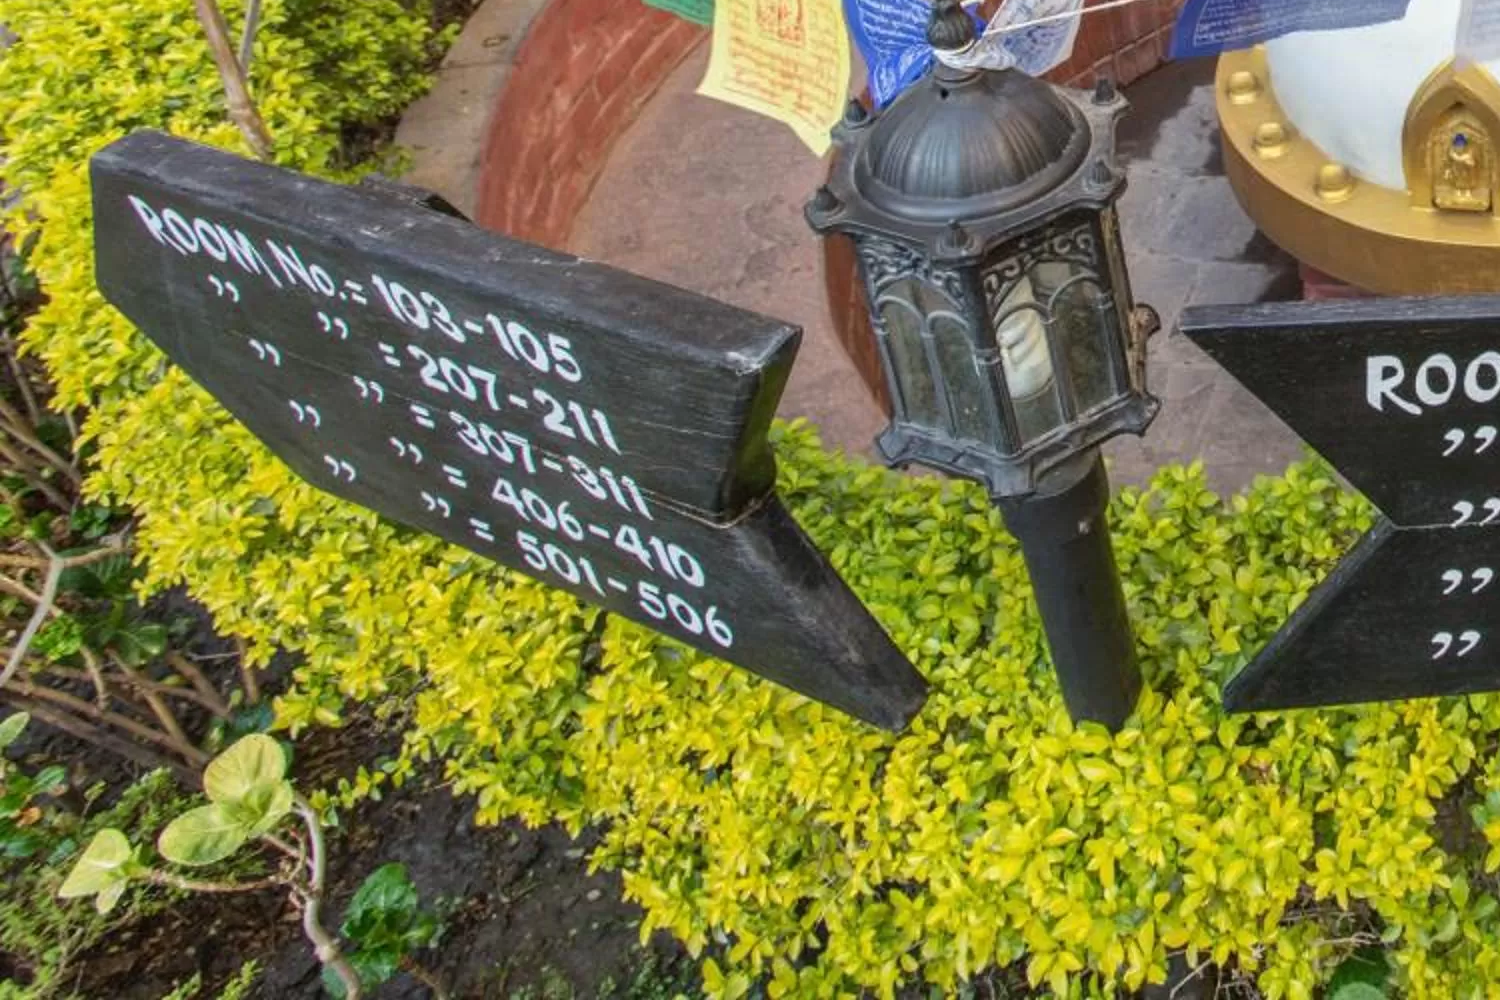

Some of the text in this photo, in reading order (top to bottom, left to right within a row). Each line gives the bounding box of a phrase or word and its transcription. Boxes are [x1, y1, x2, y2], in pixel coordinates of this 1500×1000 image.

[127, 194, 283, 290] ROOM
[371, 273, 583, 384] 103-105
[406, 344, 622, 456] 207-211
[447, 410, 654, 521] 307-311
[491, 477, 705, 588] 406-410
[516, 529, 733, 648] 501-506
